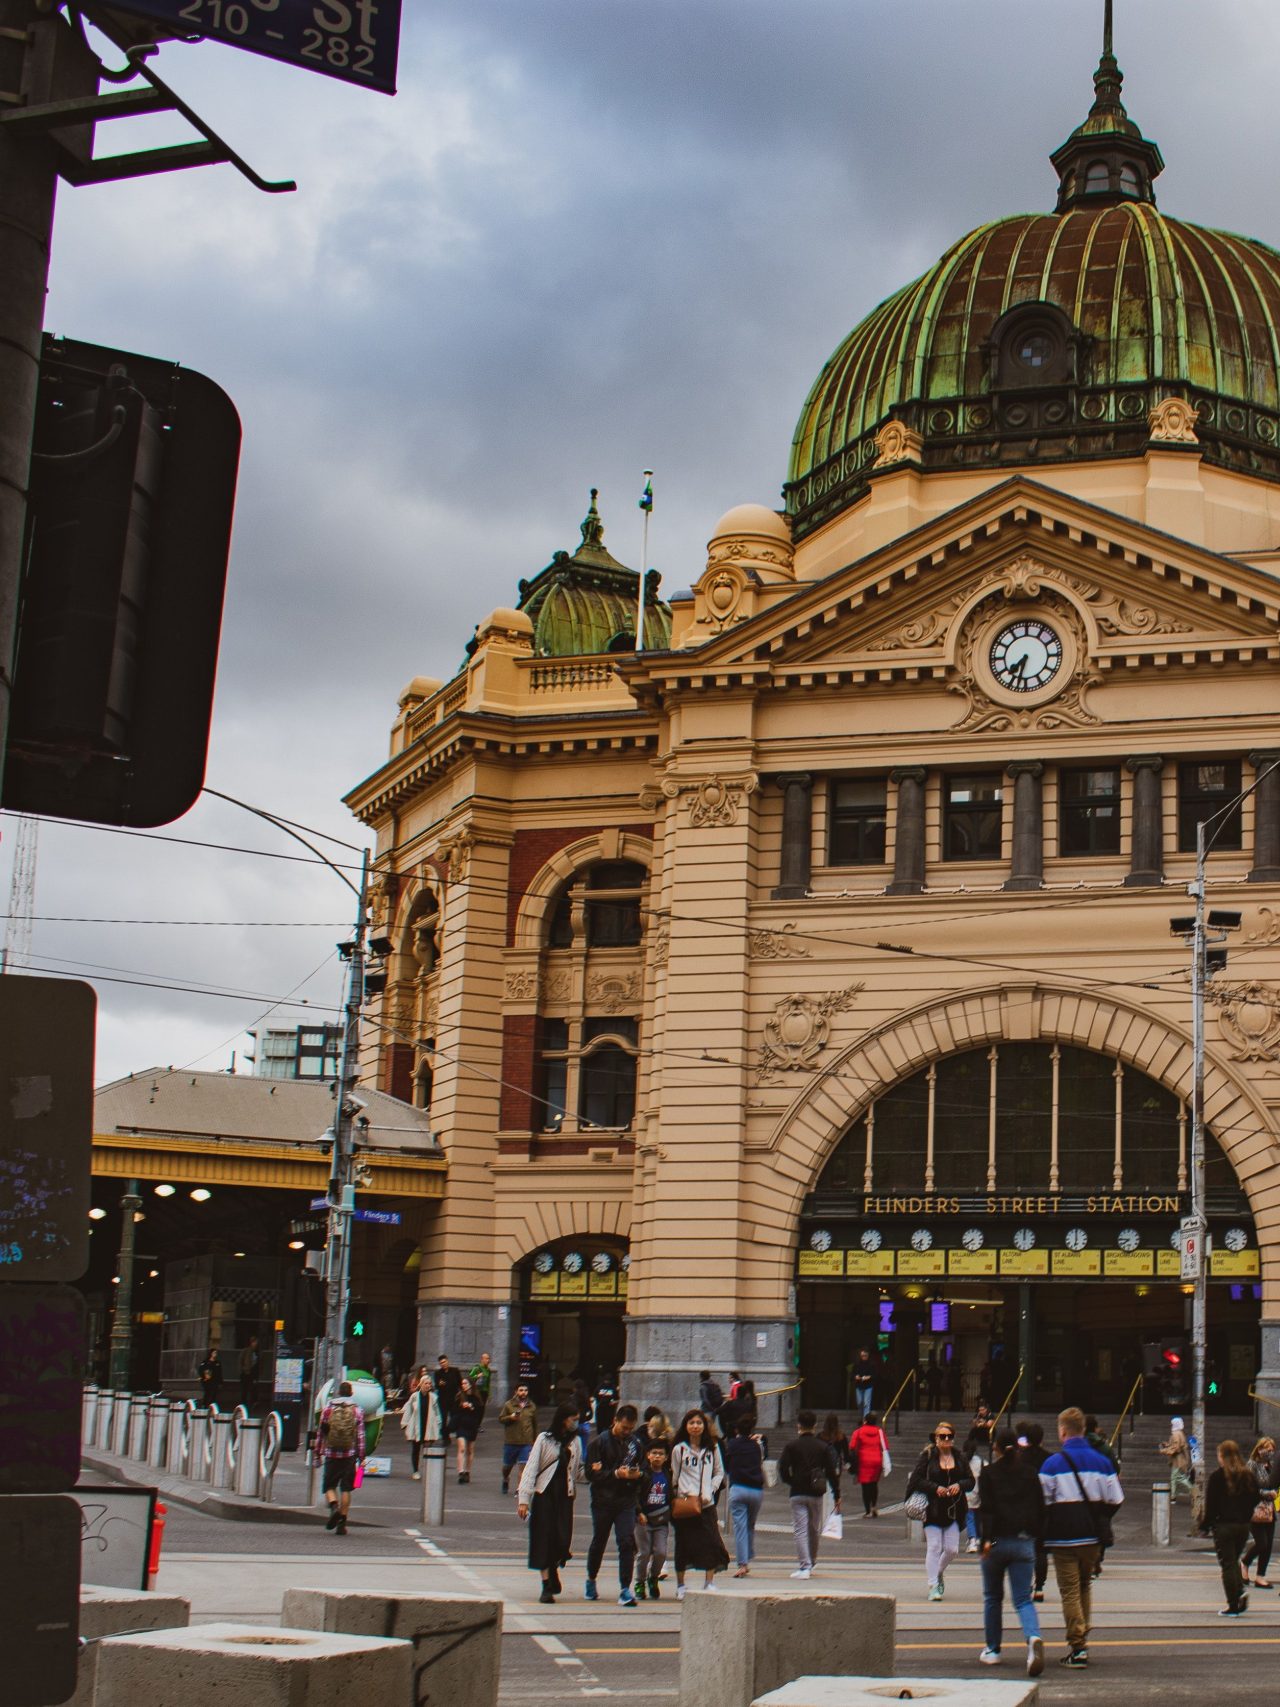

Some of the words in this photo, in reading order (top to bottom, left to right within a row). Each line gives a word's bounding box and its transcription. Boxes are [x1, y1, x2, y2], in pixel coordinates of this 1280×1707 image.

[178, 0, 249, 36] 210
[300, 28, 375, 77] 282
[313, 0, 379, 46] St
[363, 1210, 390, 1220] Flinders
[864, 1197, 960, 1213] FLINDERS
[987, 1197, 1062, 1213] STREET
[1087, 1196, 1179, 1213] STATION
